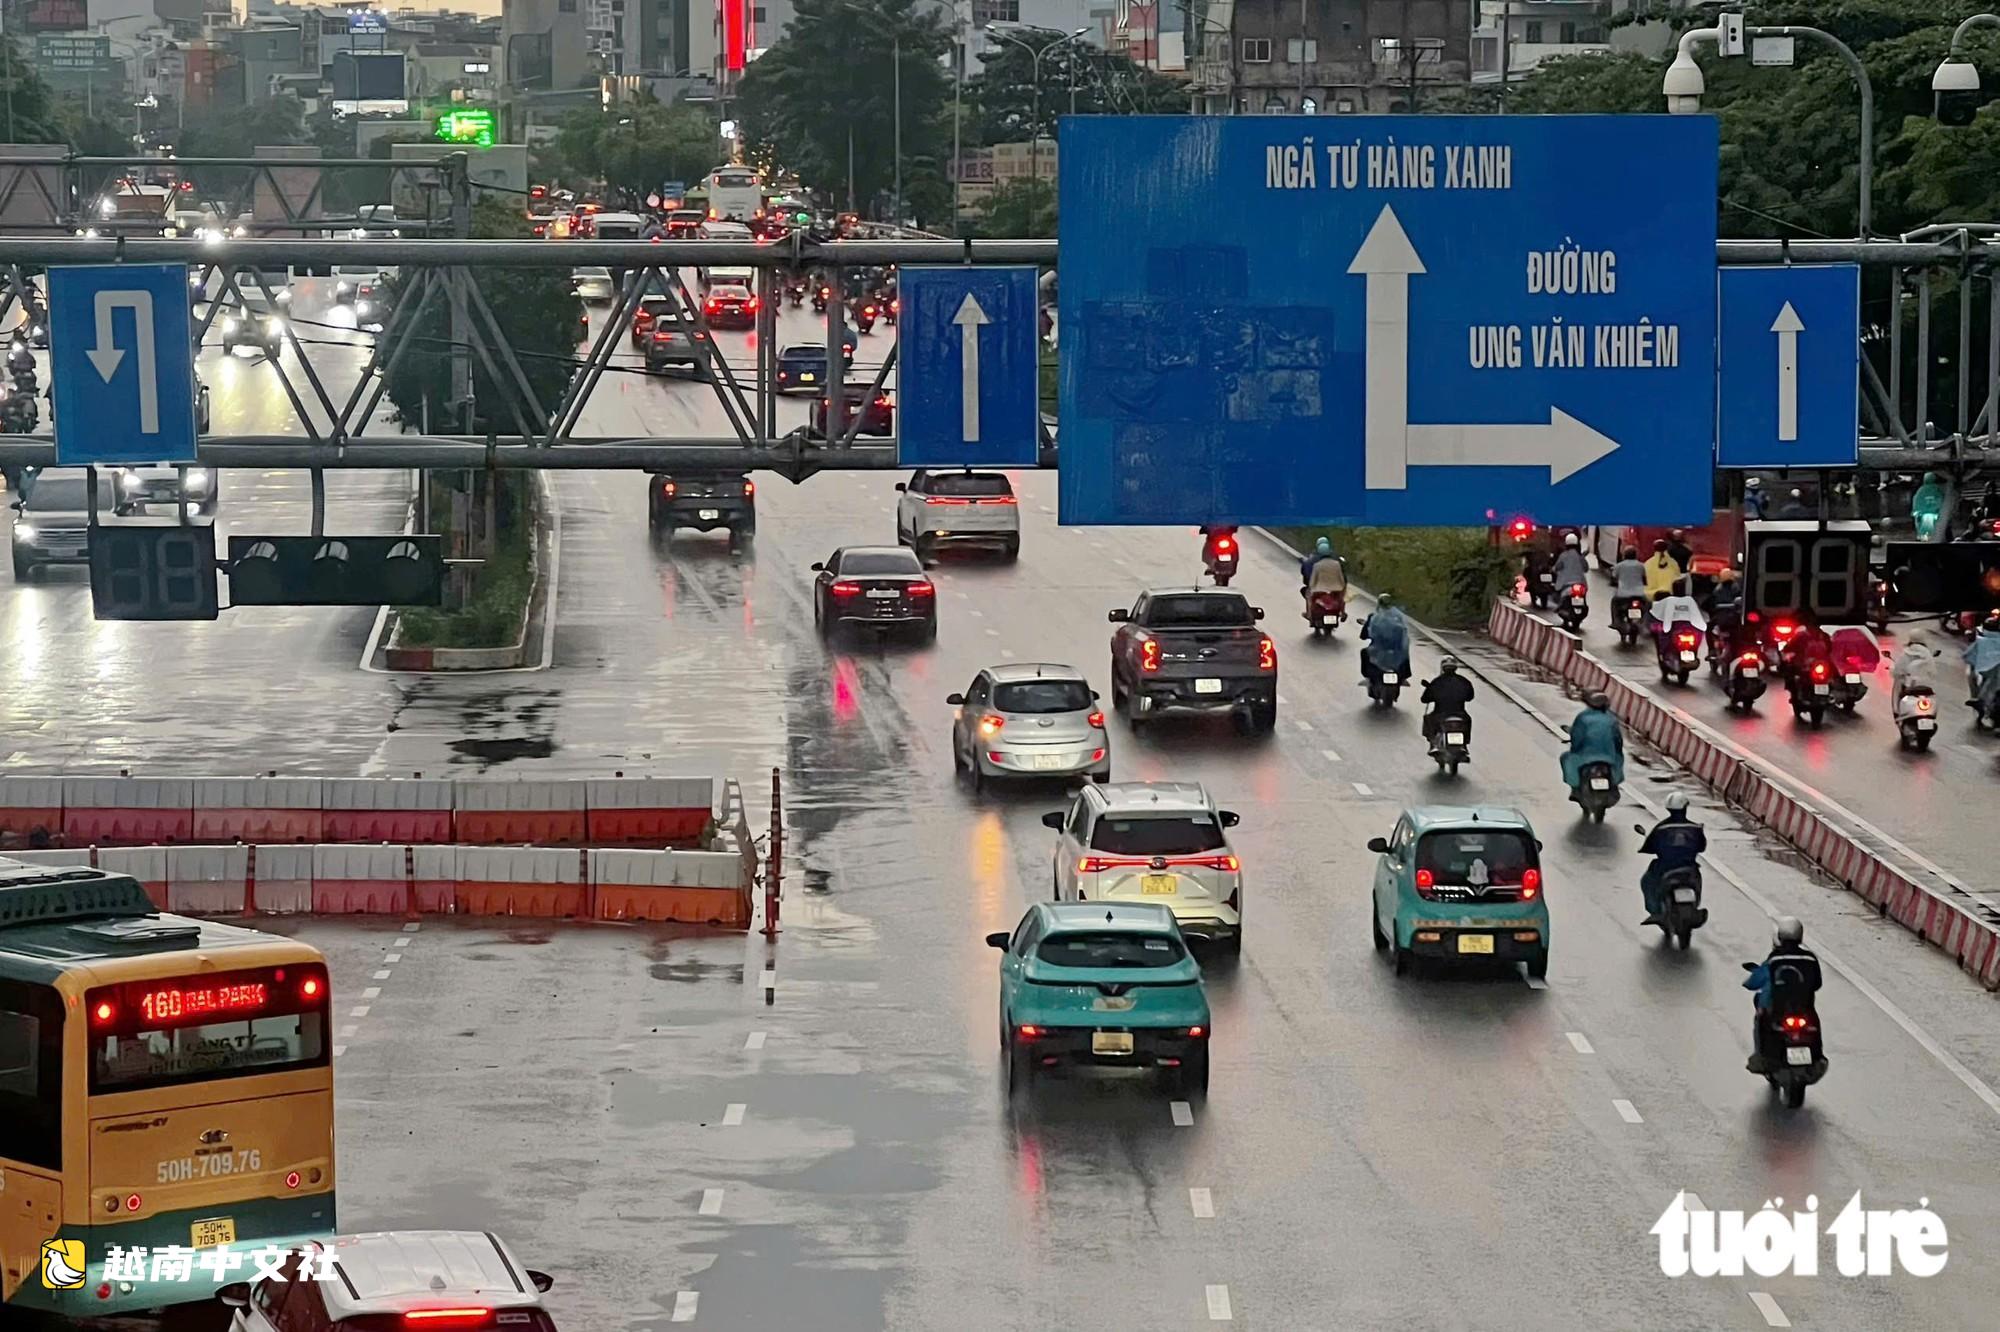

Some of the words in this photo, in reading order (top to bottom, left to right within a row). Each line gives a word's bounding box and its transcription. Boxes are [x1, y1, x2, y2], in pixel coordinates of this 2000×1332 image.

[1266, 136, 1316, 189] NGÃ
[1327, 138, 1361, 189] TƯ
[1368, 136, 1435, 189] HÀNG
[1444, 146, 1512, 189] XANH
[1526, 236, 1617, 294] ĐƯỜNG
[1469, 325, 1522, 369] UNG
[1531, 316, 1585, 368] VĂN
[1594, 316, 1679, 368] KHIÊM
[142, 990, 181, 1019] 160
[219, 983, 264, 1009] PARK
[157, 1149, 261, 1184] 50H-709.76
